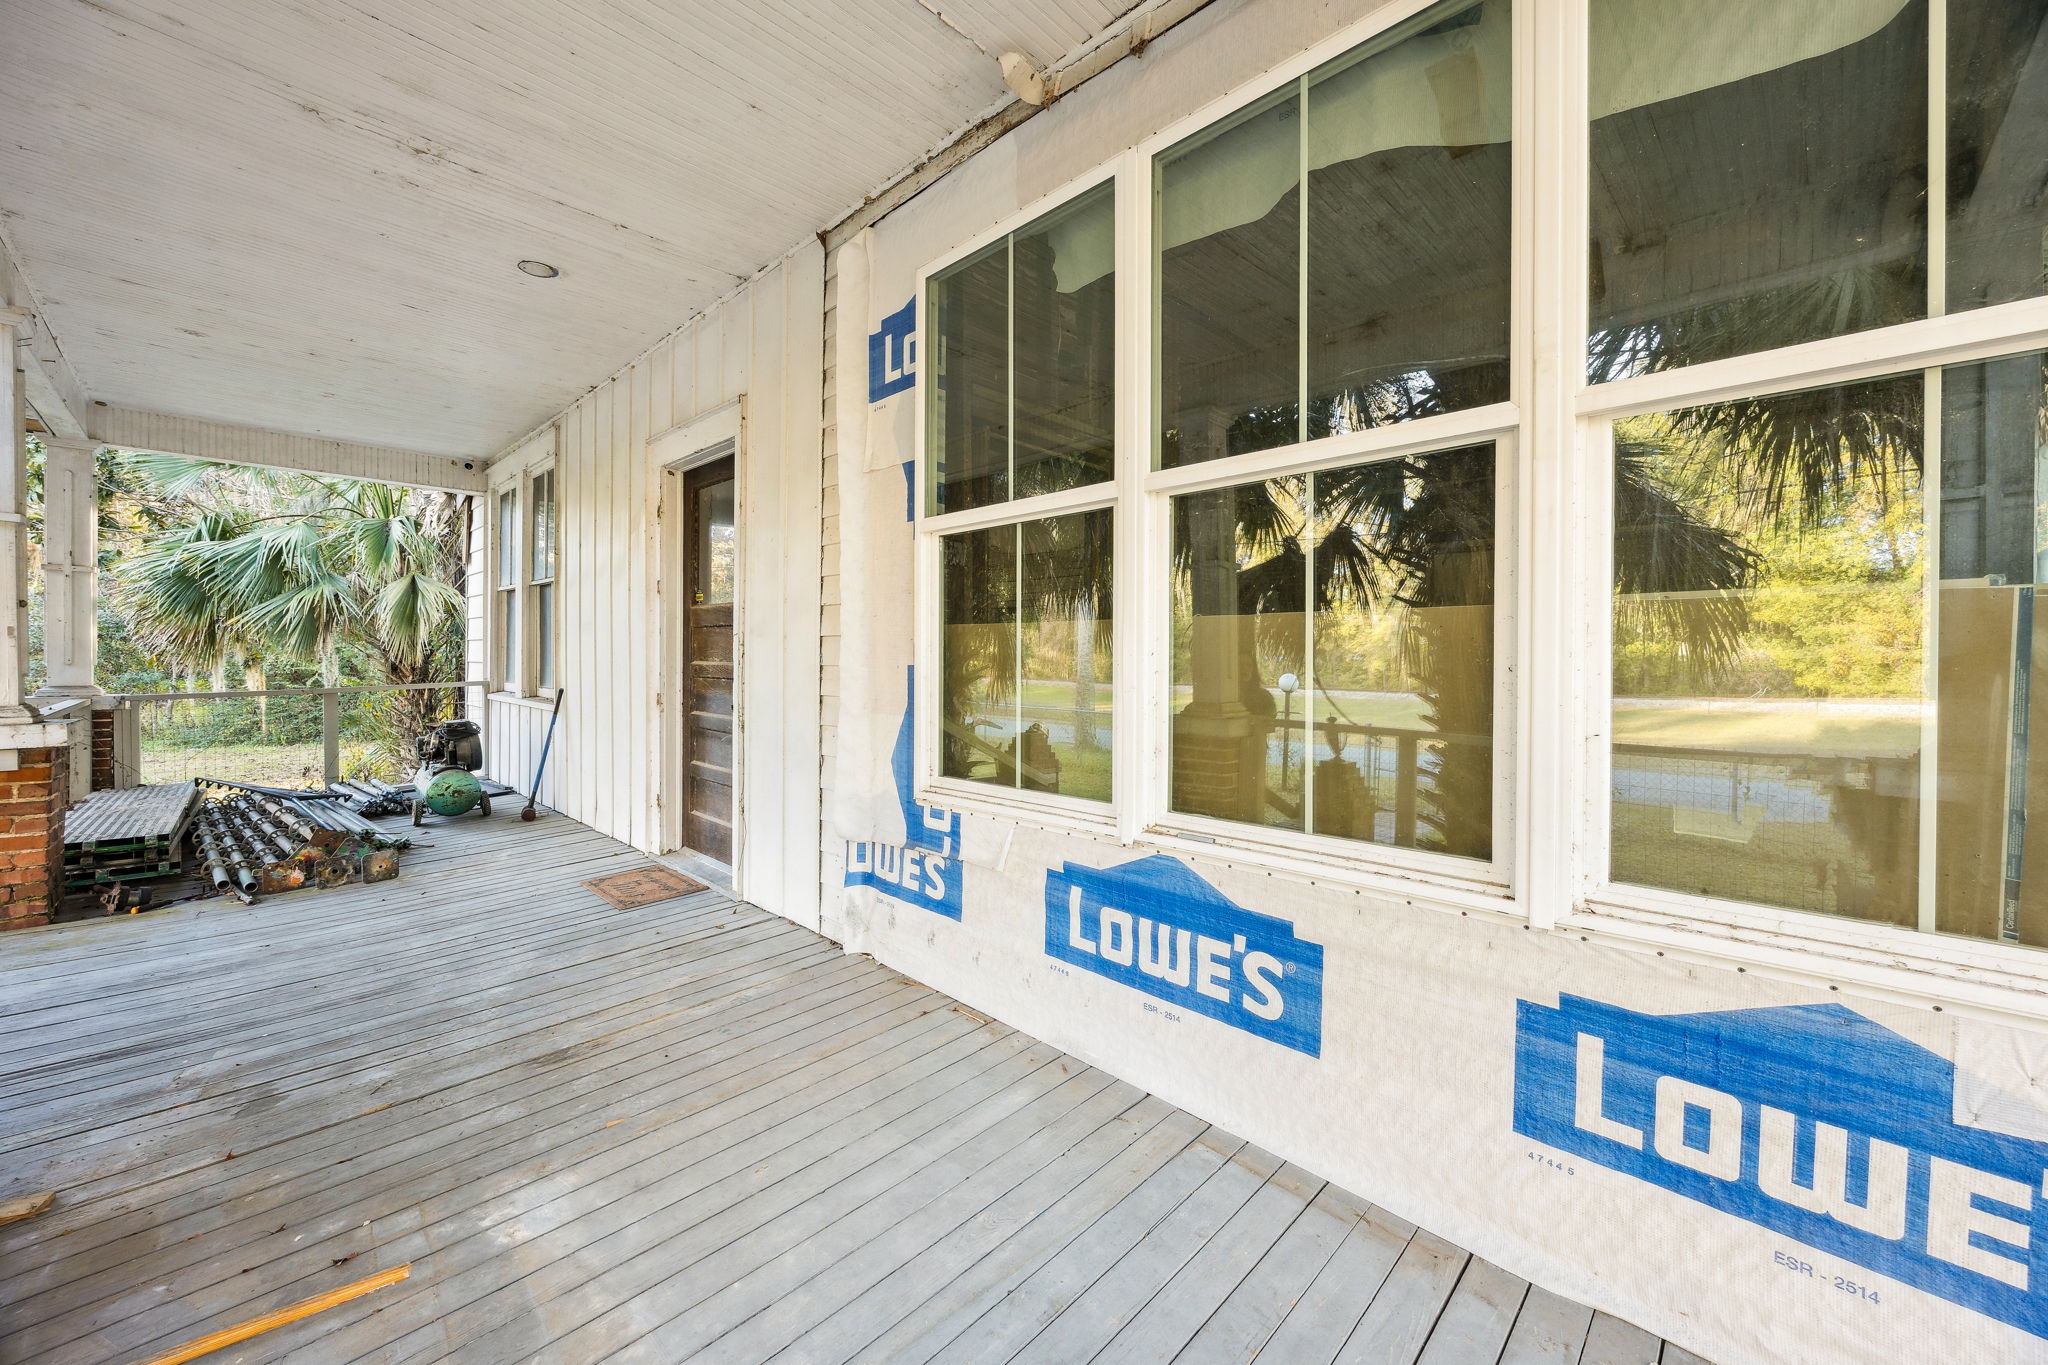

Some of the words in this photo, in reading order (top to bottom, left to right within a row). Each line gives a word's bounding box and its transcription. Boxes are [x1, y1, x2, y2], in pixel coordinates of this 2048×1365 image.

[848, 840, 946, 901] OWES
[1069, 885, 1284, 1021] LOWE'S
[1143, 1002, 1158, 1013] ESR
[1164, 1011, 1181, 1023] 2514
[1528, 1151, 1575, 1176] 47445
[1575, 1031, 2048, 1291] LOWE
[1774, 1250, 1813, 1278] ESR
[1834, 1276, 1880, 1304] 2514
